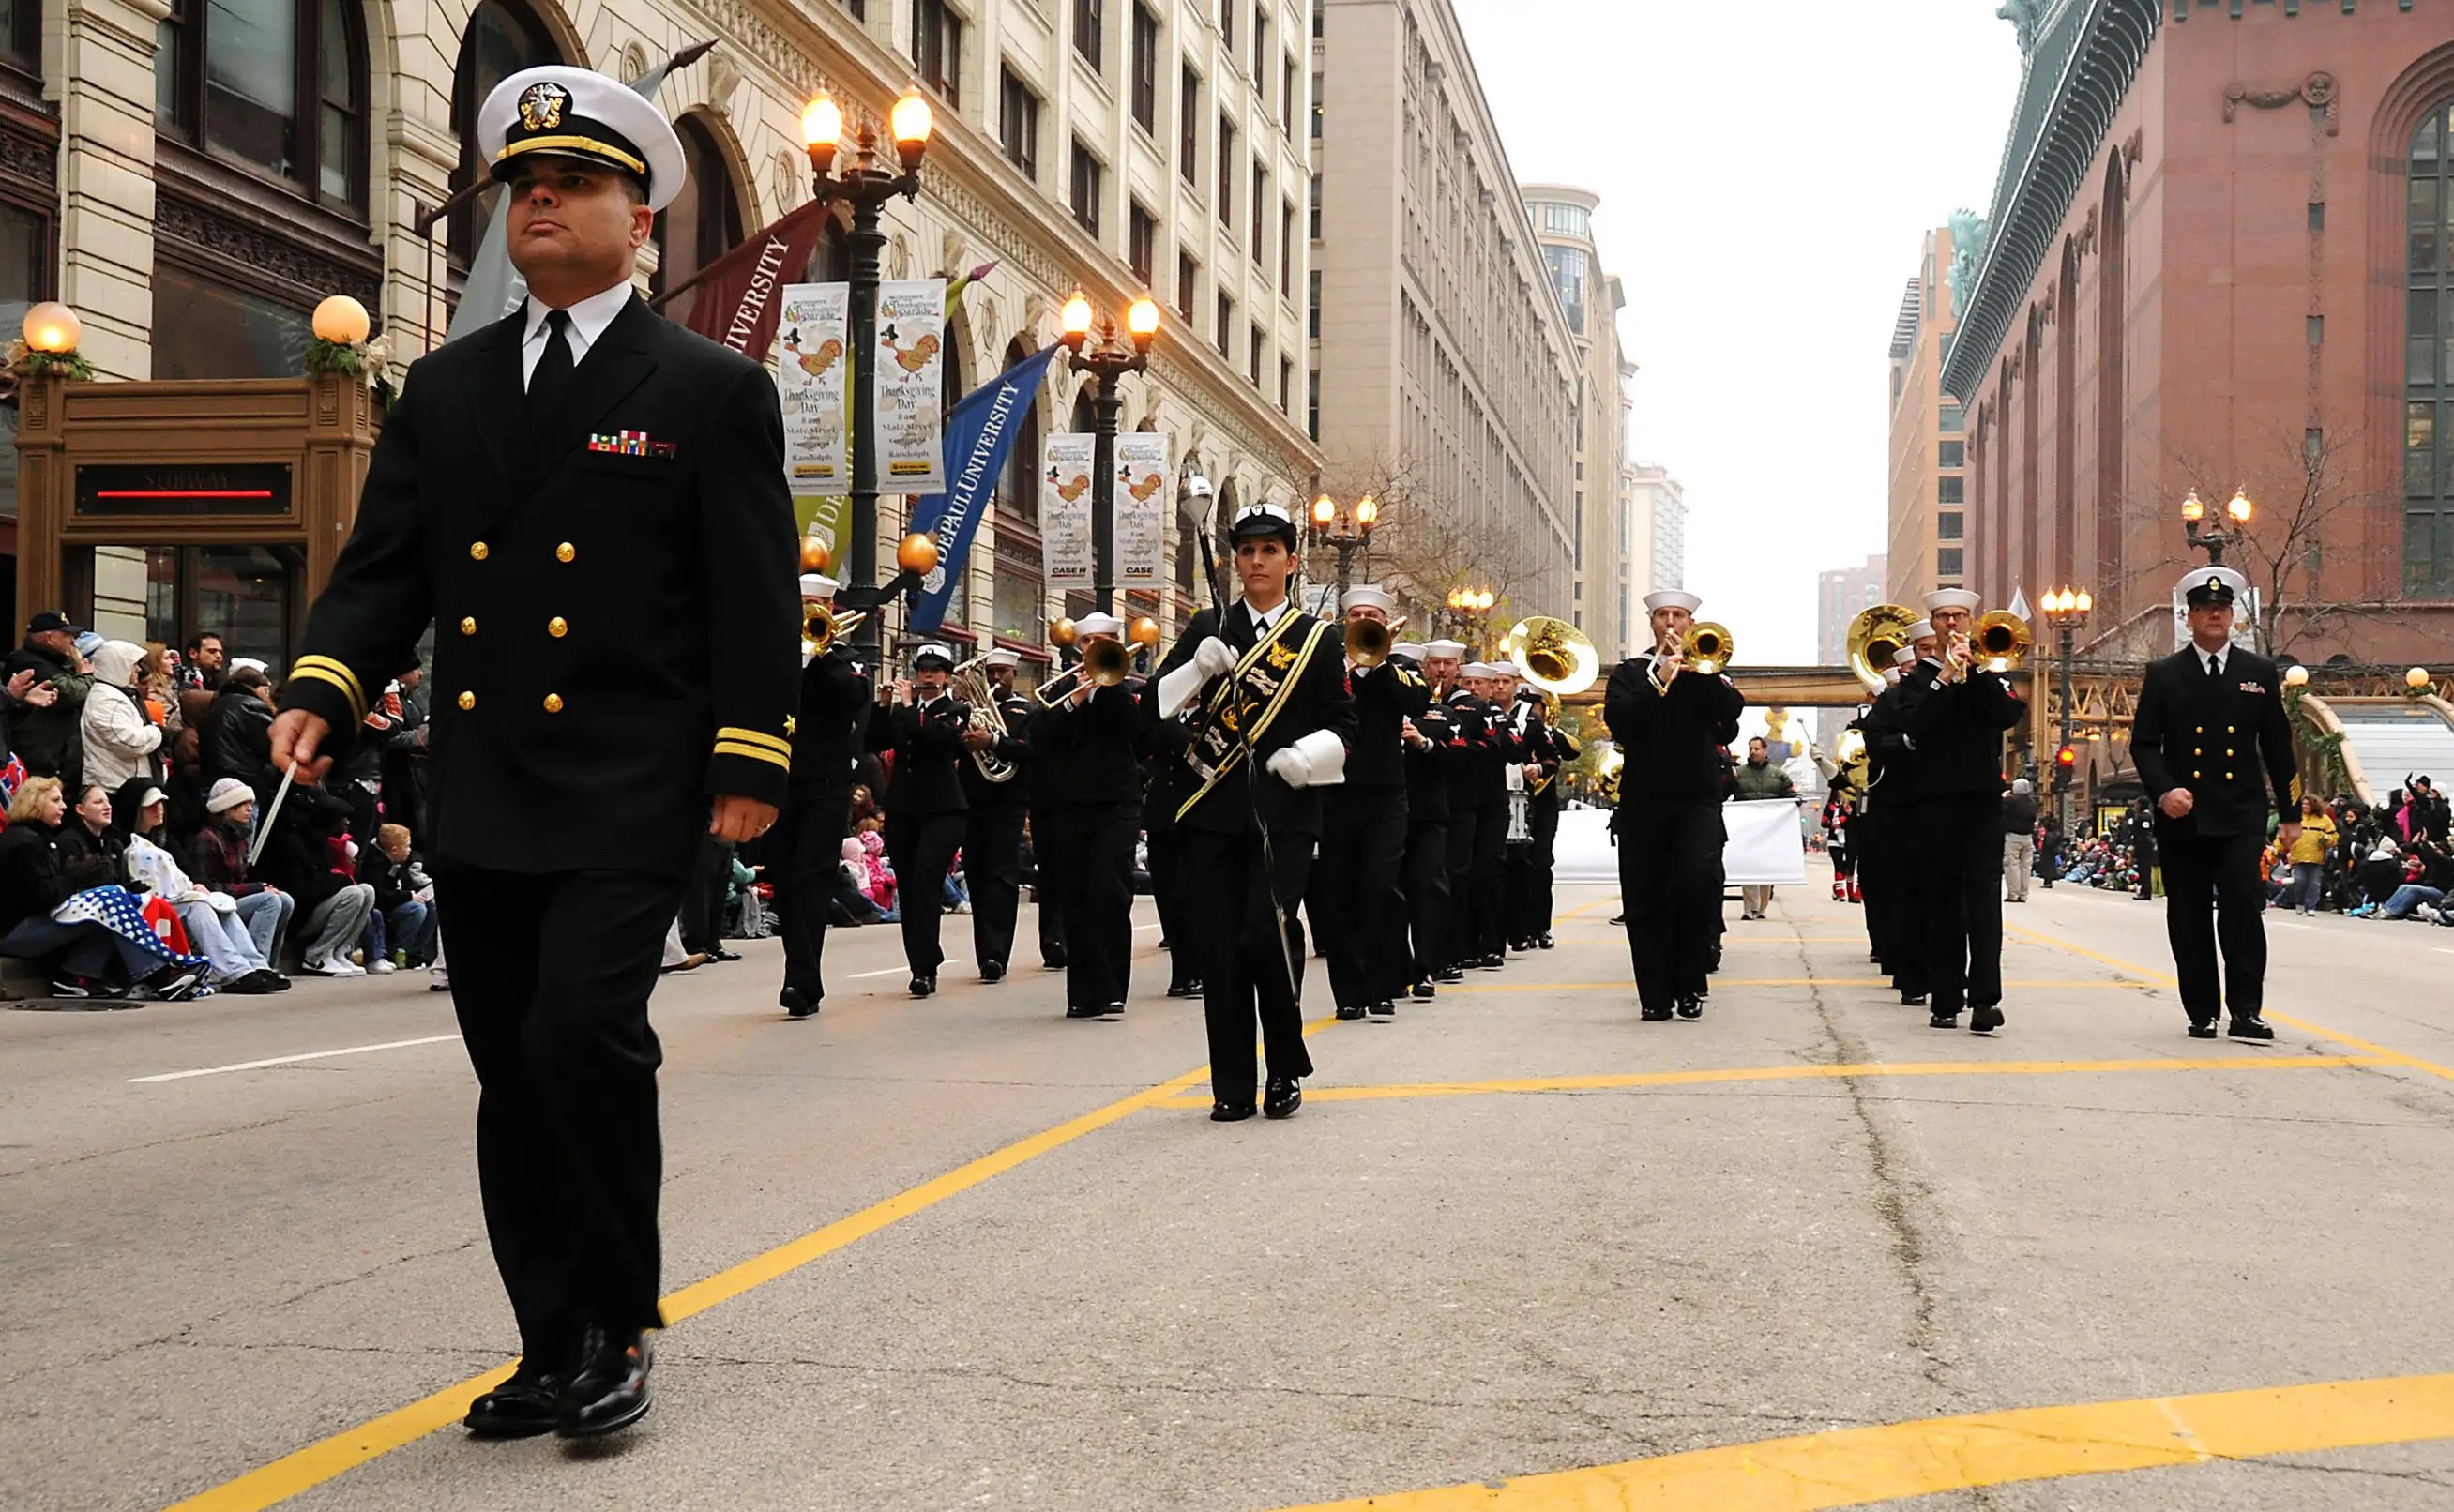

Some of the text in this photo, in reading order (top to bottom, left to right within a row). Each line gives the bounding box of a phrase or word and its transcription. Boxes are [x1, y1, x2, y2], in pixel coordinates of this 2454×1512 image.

[723, 234, 789, 353] IVERSITY
[784, 389, 840, 402] Thanksgiving
[881, 385, 936, 399] Thanksgiving
[801, 401, 818, 416] Day
[897, 398, 916, 412] Day
[957, 380, 1019, 493] UNIVERSITY
